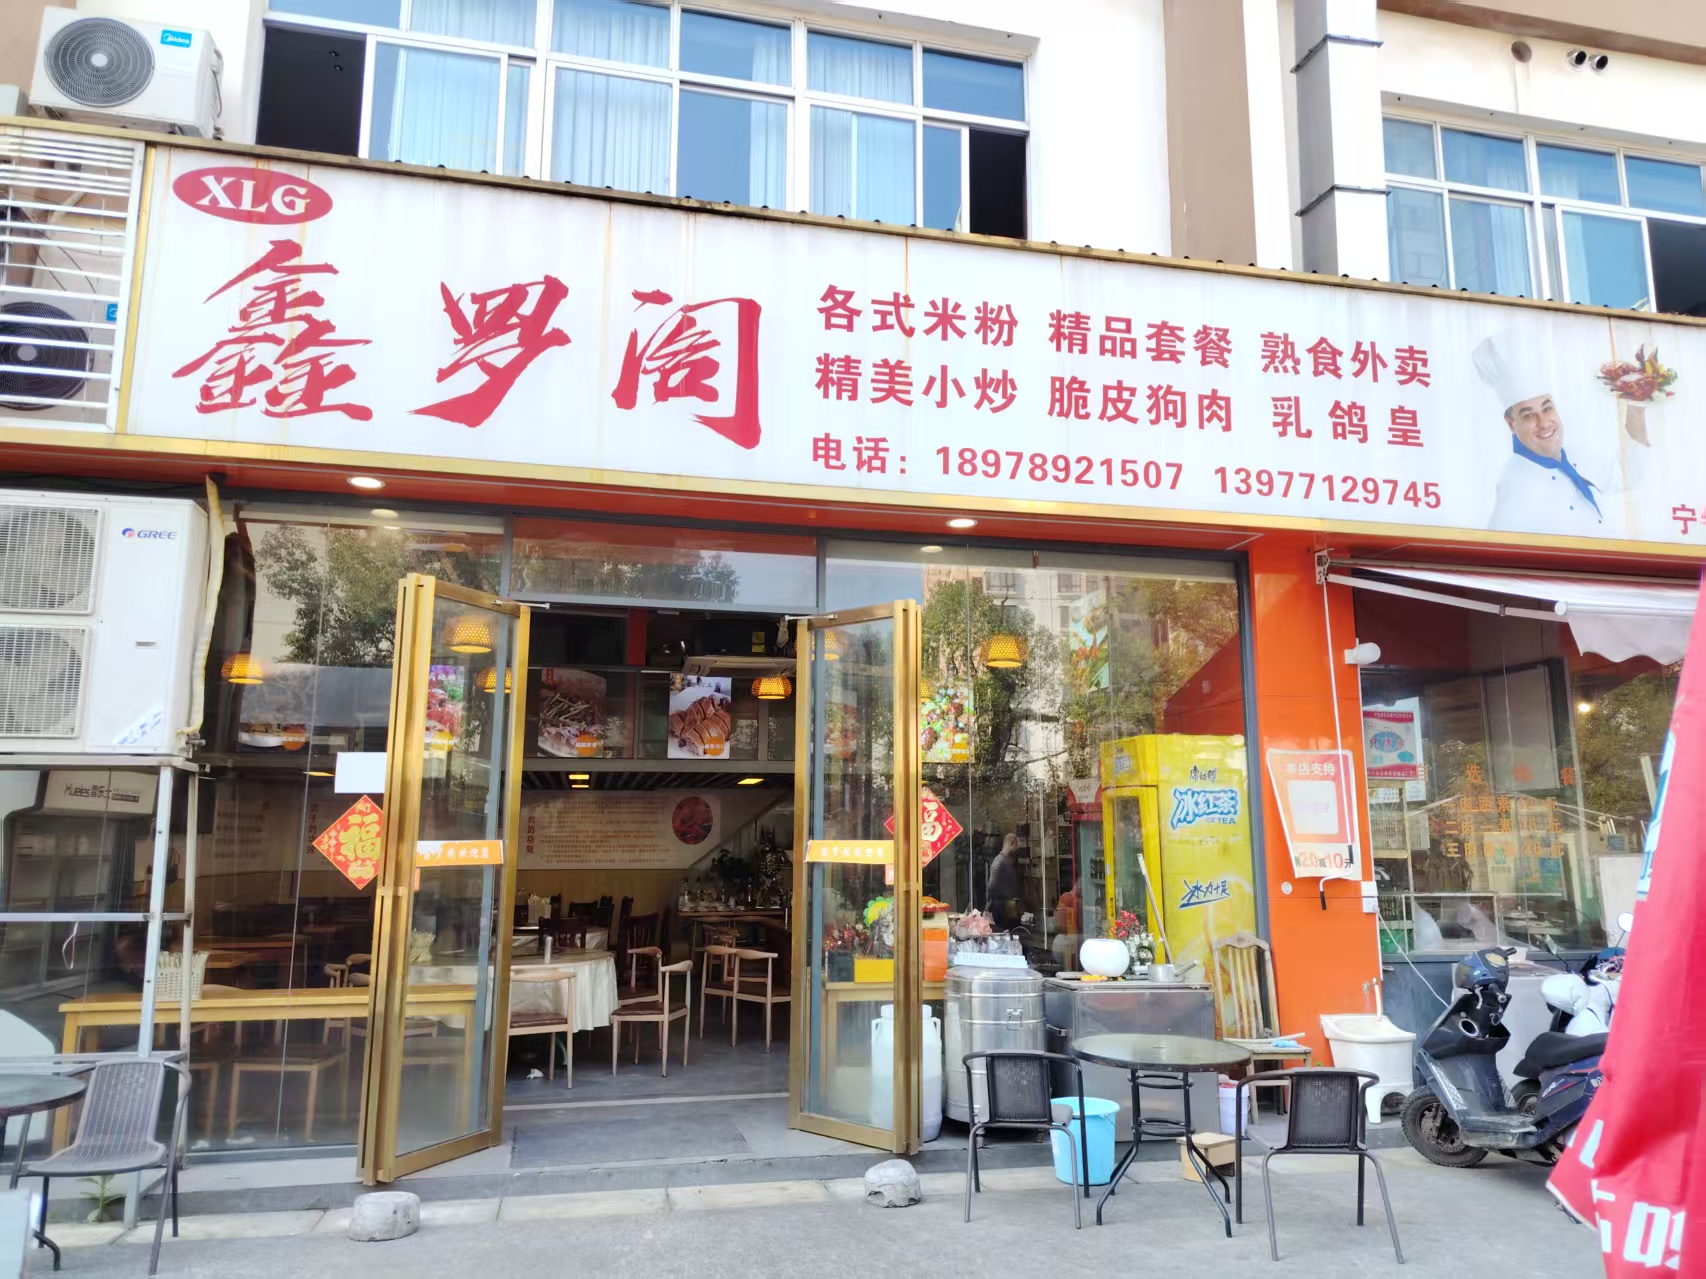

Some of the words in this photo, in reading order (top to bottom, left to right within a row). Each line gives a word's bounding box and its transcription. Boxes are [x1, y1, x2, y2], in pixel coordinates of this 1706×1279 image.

[195, 175, 311, 216] XLG
[816, 285, 1019, 347] 各式米粉
[1048, 309, 1233, 369] 精品套餐
[1260, 331, 1431, 388] 熟食外卖
[814, 353, 1018, 414] 精美小炒
[1047, 375, 1233, 433] 脆皮狗肉
[1271, 395, 1425, 448] 乳鸽皇
[936, 446, 1183, 490] 18978921507
[1214, 466, 1442, 509] 13977129745
[137, 530, 177, 540] GREE
[1672, 503, 1706, 535] 宁
[1171, 788, 1238, 830] 冰红茶
[1217, 817, 1236, 825] TEA
[1179, 880, 1231, 905] 冰力十足
